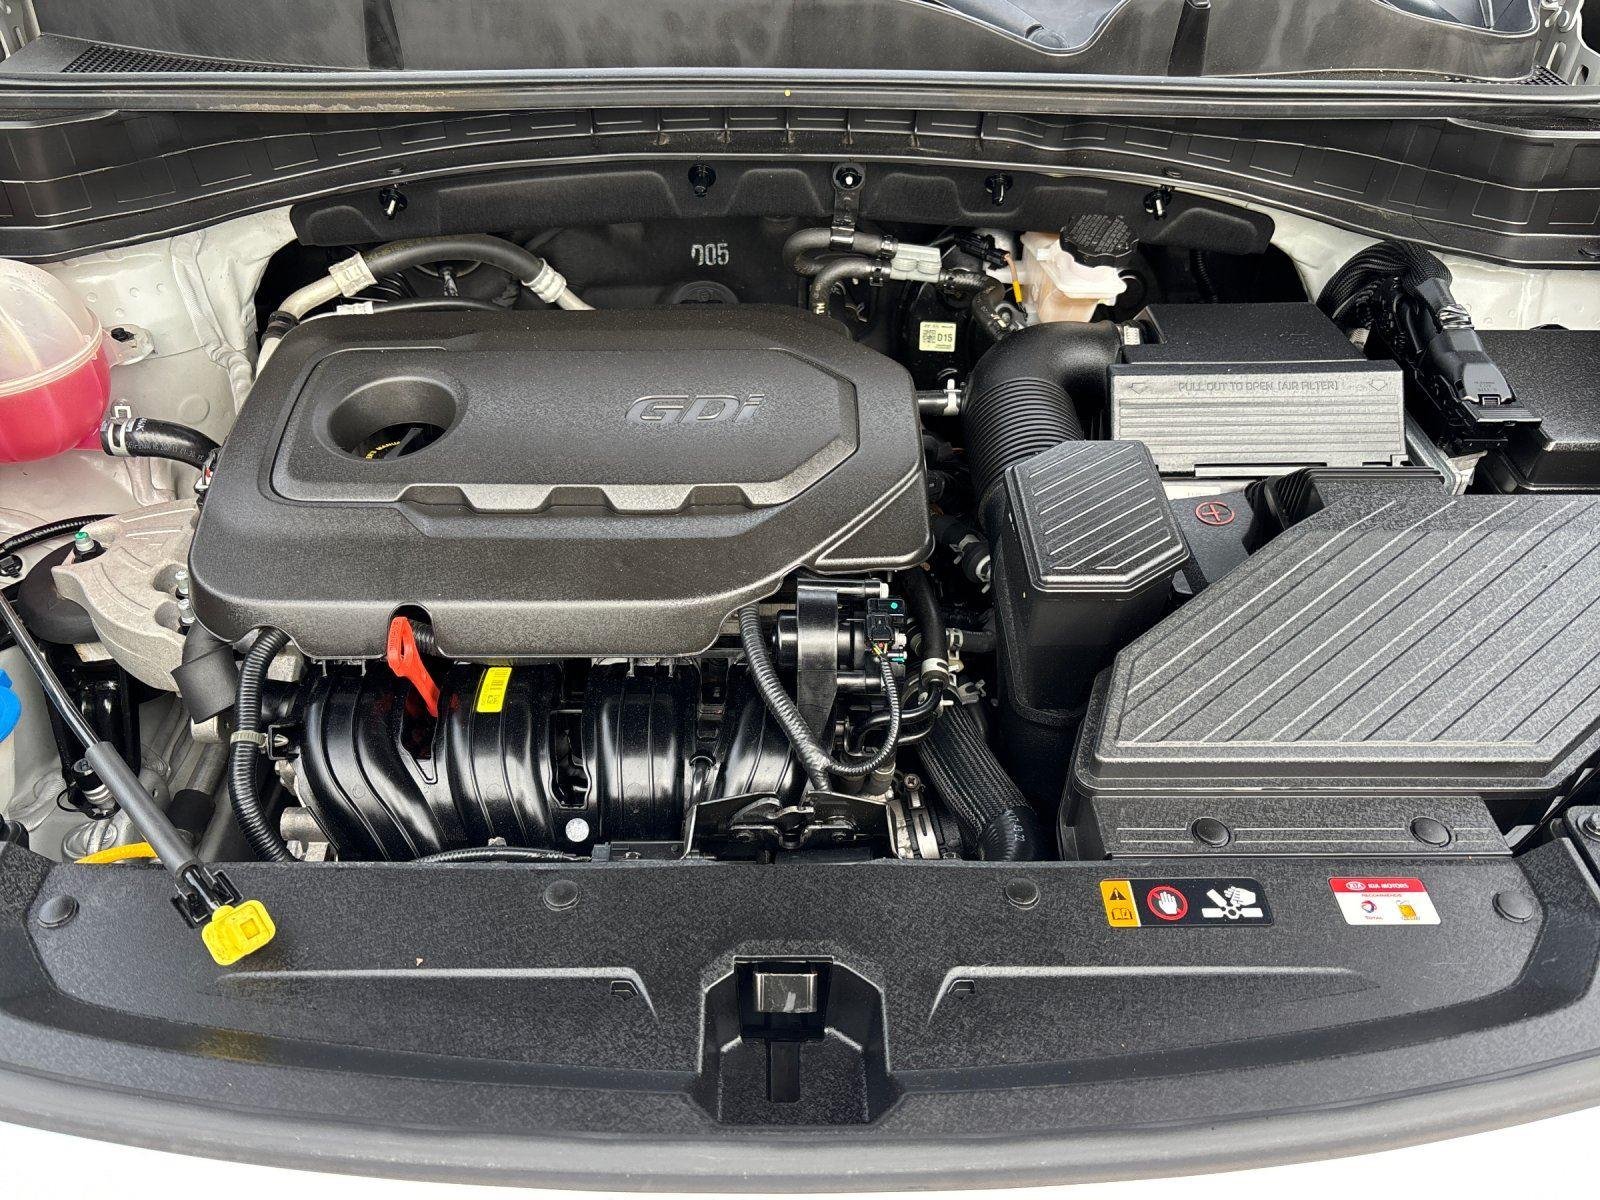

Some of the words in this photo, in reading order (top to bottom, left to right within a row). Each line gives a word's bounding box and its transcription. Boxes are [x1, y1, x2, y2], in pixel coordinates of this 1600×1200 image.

[1179, 382, 1205, 391] PULL
[1206, 382, 1228, 391] OUT
[1229, 381, 1244, 391] TO
[1245, 381, 1273, 390] OPEN
[624, 393, 765, 423] GDi
